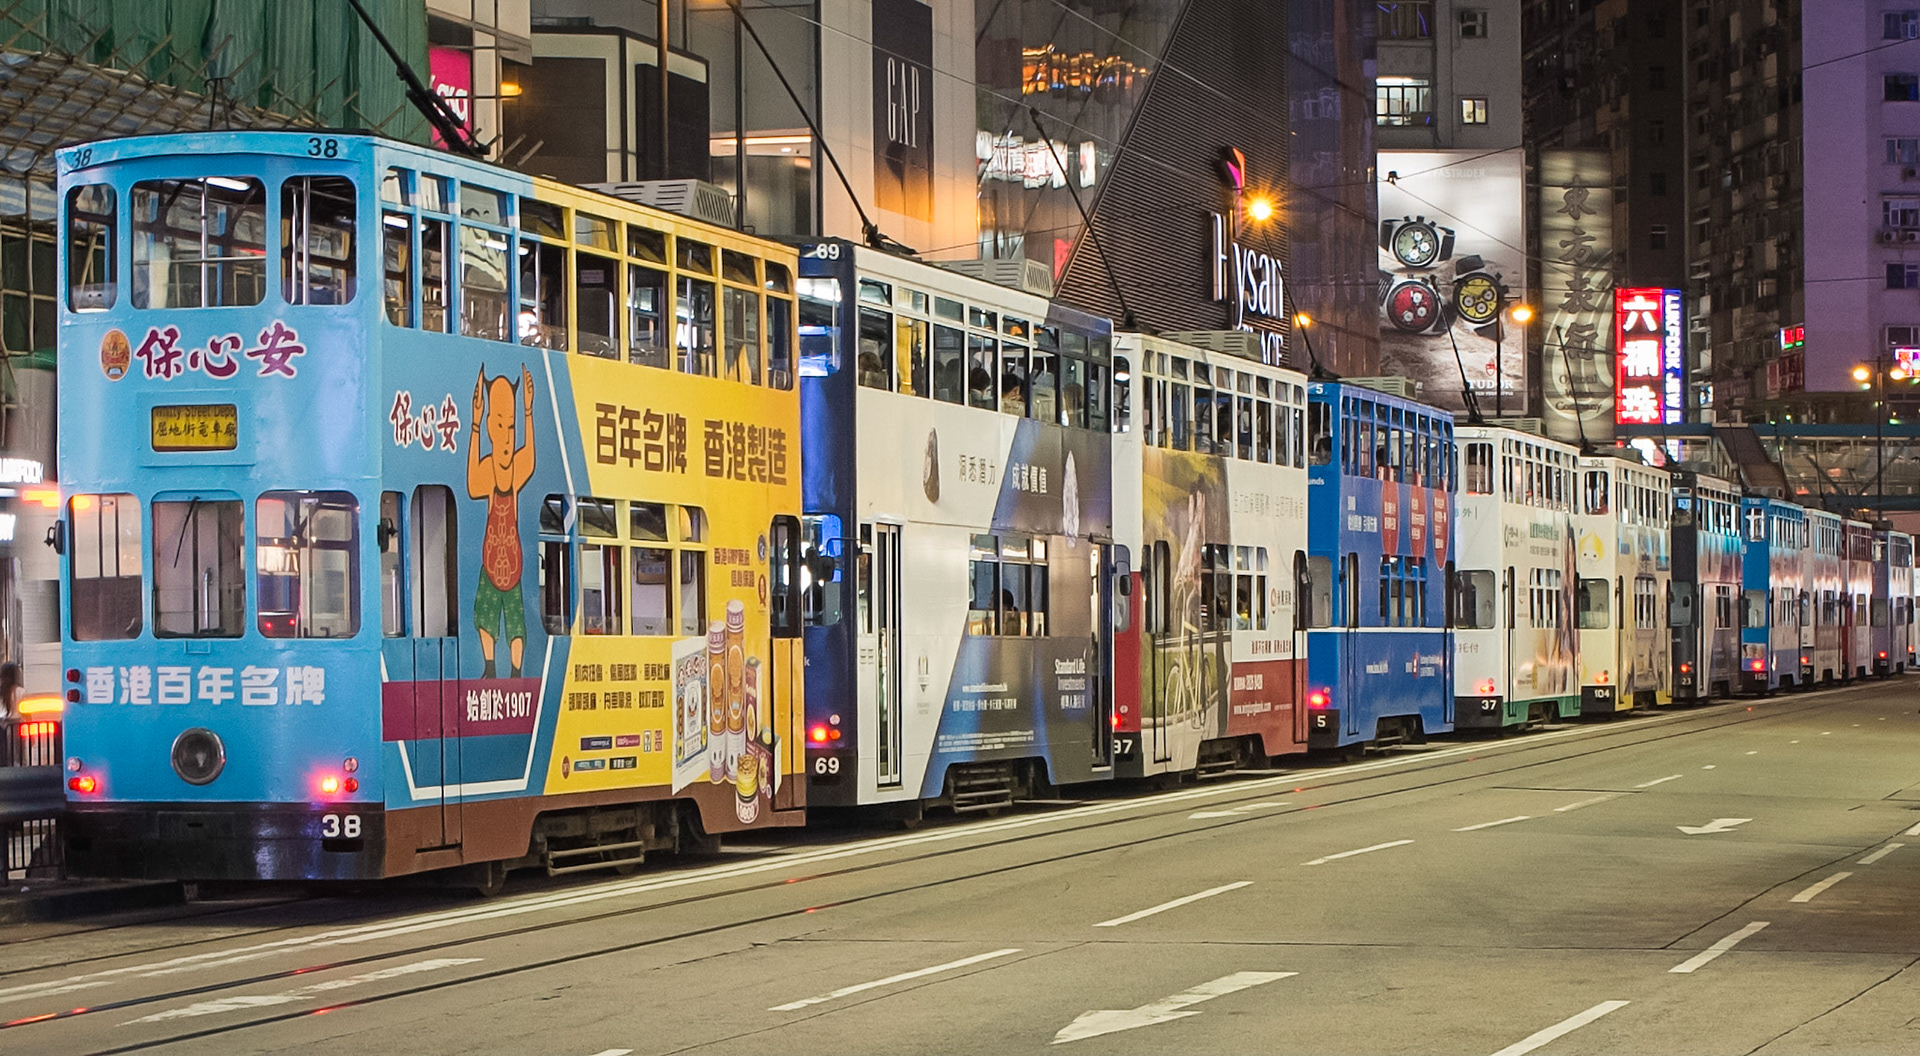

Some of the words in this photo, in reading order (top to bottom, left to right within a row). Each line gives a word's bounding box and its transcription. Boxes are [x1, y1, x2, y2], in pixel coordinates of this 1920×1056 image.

[887, 57, 920, 148] GAP
[72, 149, 92, 168] 38
[307, 137, 339, 158] 38
[816, 243, 840, 260] 69
[1213, 212, 1284, 332] Hysan
[136, 321, 306, 379] 保心安
[1315, 383, 1324, 395] 5
[1622, 294, 1659, 466] 六福珠
[185, 405, 211, 419] Street
[390, 392, 460, 451] 保心安
[595, 402, 687, 475] 百年名牌
[704, 419, 787, 486] 香港製造
[86, 665, 326, 706] 香港百年名牌
[1594, 689, 1610, 699] 104
[466, 689, 532, 723] 始創於1907
[1481, 700, 1497, 711] 37
[1316, 715, 1327, 728] 5
[815, 757, 840, 775] 69
[322, 814, 362, 838] 38
